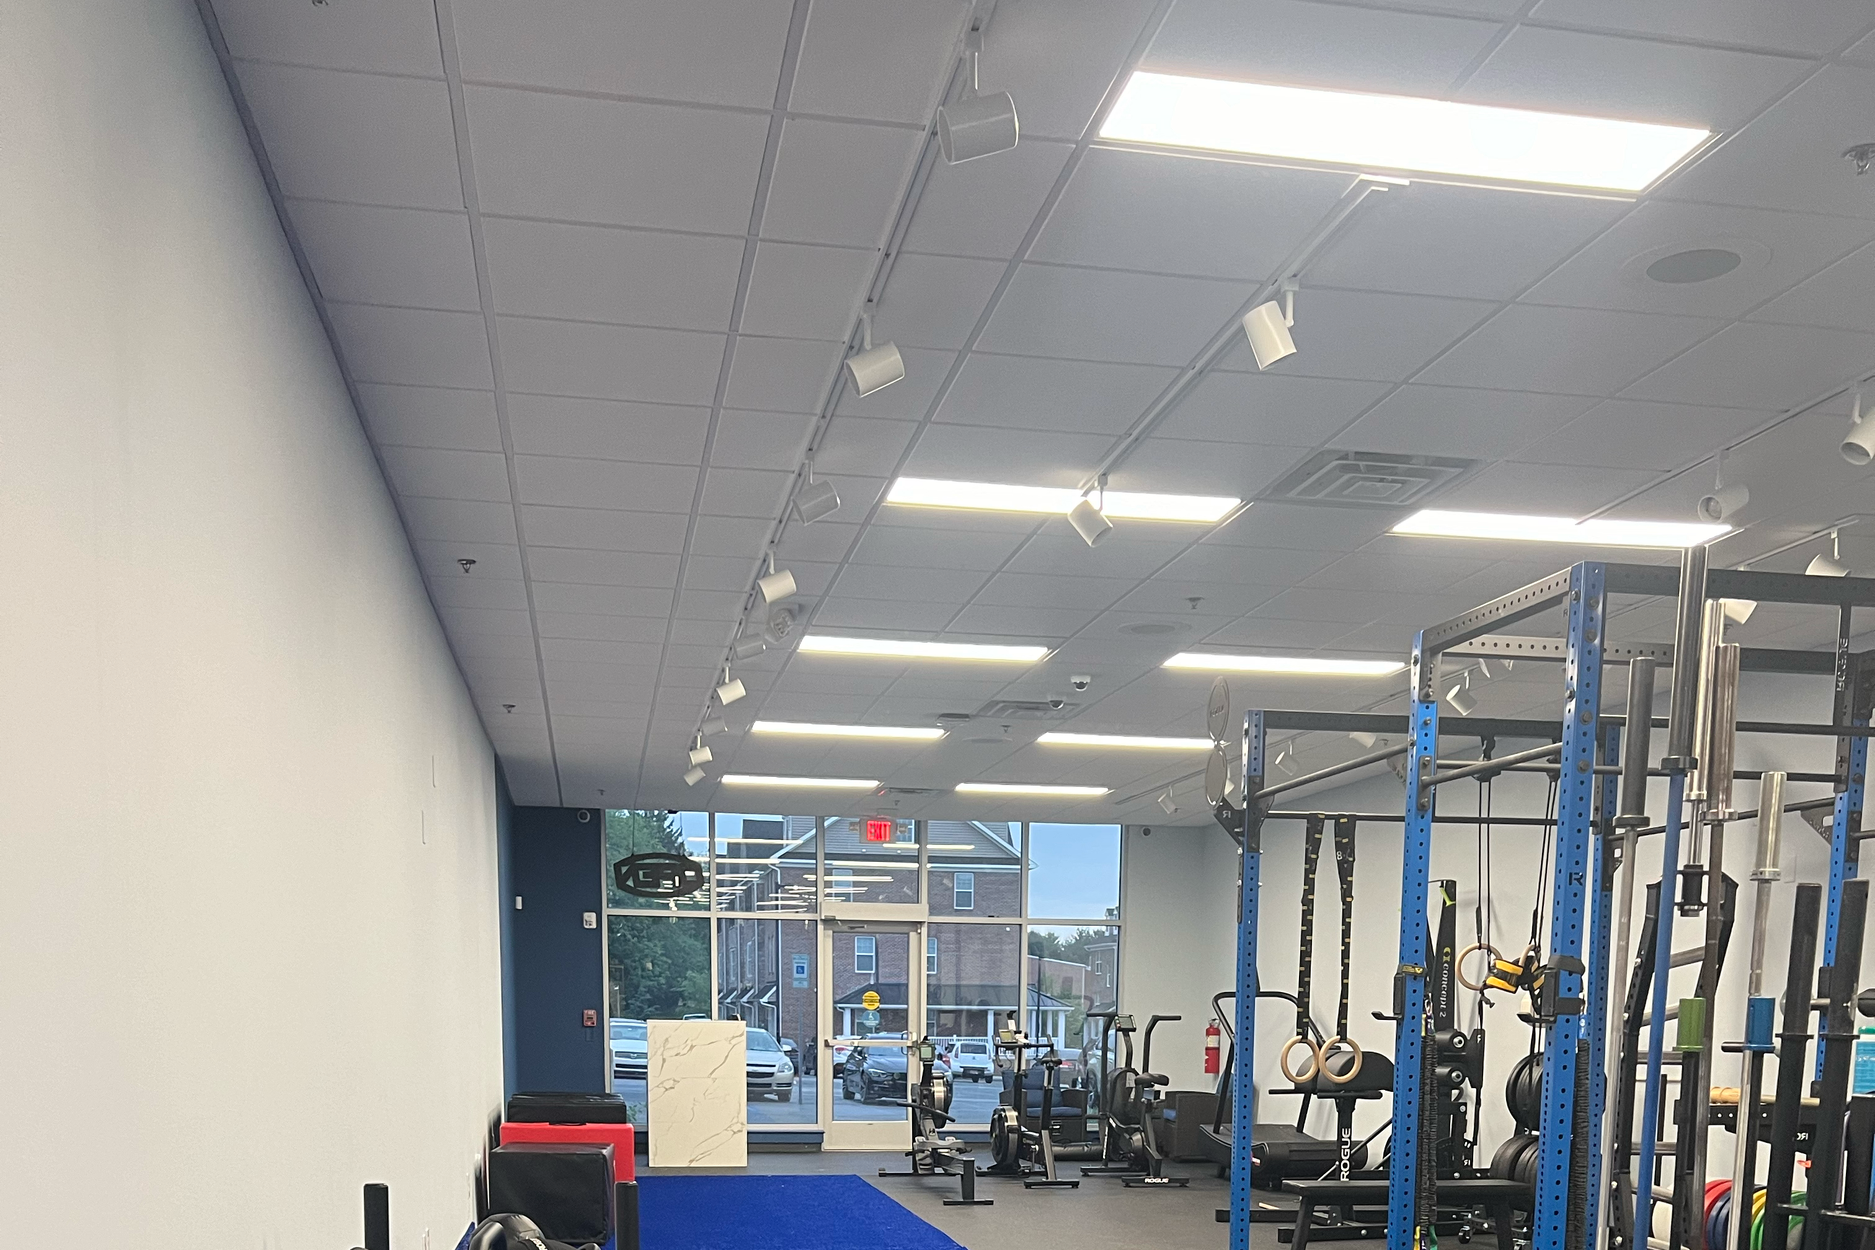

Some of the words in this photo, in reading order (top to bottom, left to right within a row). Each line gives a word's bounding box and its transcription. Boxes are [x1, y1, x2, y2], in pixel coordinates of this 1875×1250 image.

[867, 820, 891, 841] EXIT
[1569, 872, 1583, 886] R
[1440, 963, 1449, 1009] concept
[1340, 1127, 1351, 1181] ROGUE
